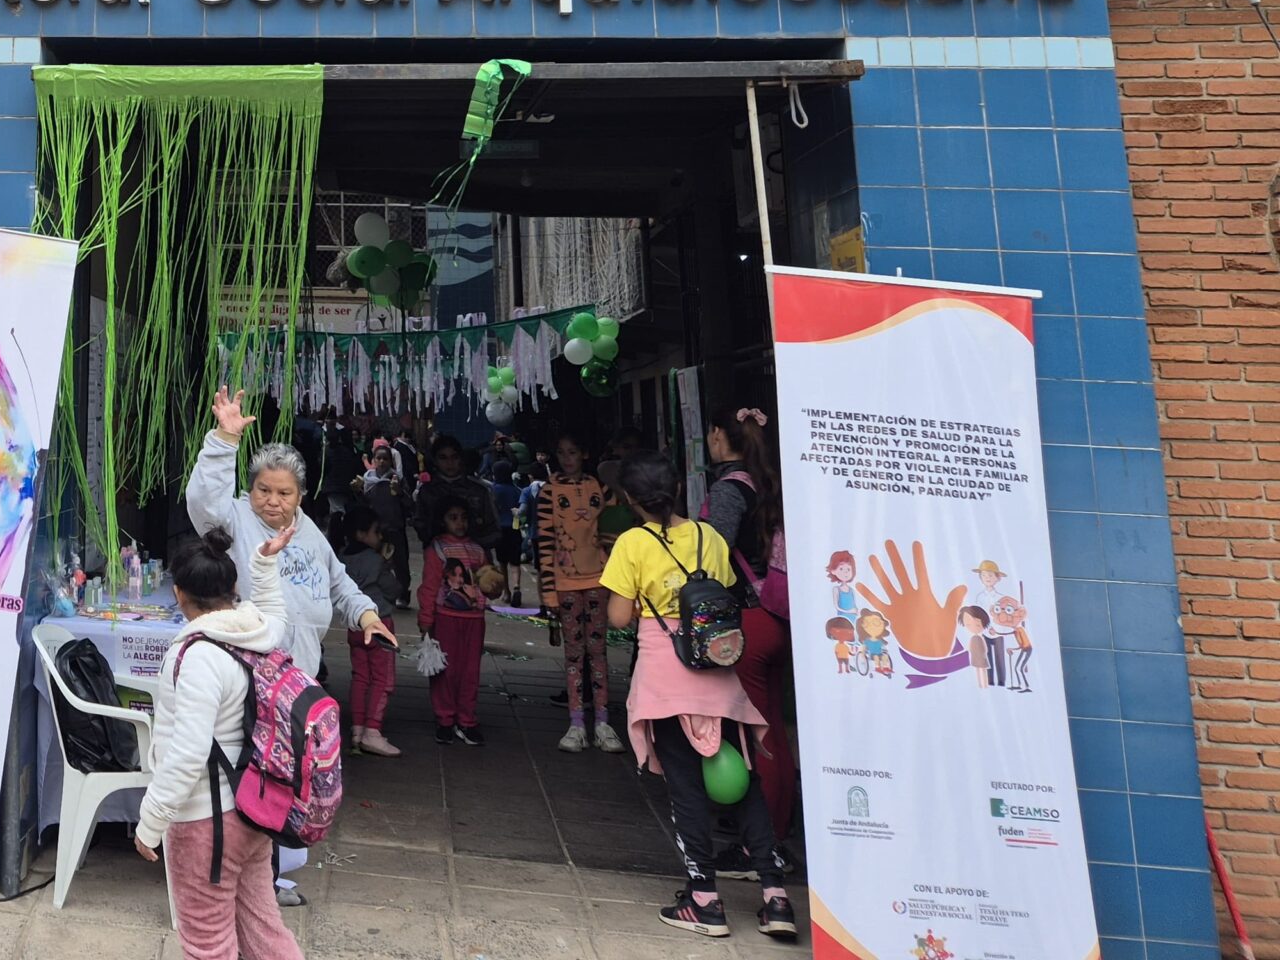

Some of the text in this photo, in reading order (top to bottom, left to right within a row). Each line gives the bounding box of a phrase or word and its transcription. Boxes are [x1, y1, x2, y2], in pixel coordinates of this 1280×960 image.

[334, 307, 352, 315] ser
[811, 420, 1013, 448] EN LAS REDES DE SALUD PARA LA
[920, 419, 936, 428] DE
[940, 421, 1021, 437] ESTRATEGIAS
[810, 431, 1015, 459] PREVENCIÓN Y PROMOCIÓN DE LA
[810, 442, 1017, 470] ATENCIÓN INTEGRAL A PERSONAS
[800, 453, 1029, 483] AFECTADAS POR VIOLENCIA FAMILIAR
[820, 466, 1012, 493] Y DE GÉNERO EN LA CIUDAD DE
[845, 480, 915, 496] ASUNCIÓN,
[122, 636, 169, 645] NO DEJEMOS
[145, 644, 169, 652] ROBEN
[822, 766, 893, 780] FINANCIADO POR:
[991, 781, 1034, 792] EJECUTADO
[1010, 805, 1060, 819] CEAMSO
[998, 825, 1024, 837] fuden
[913, 884, 989, 898] CON EL APOYO DE:
